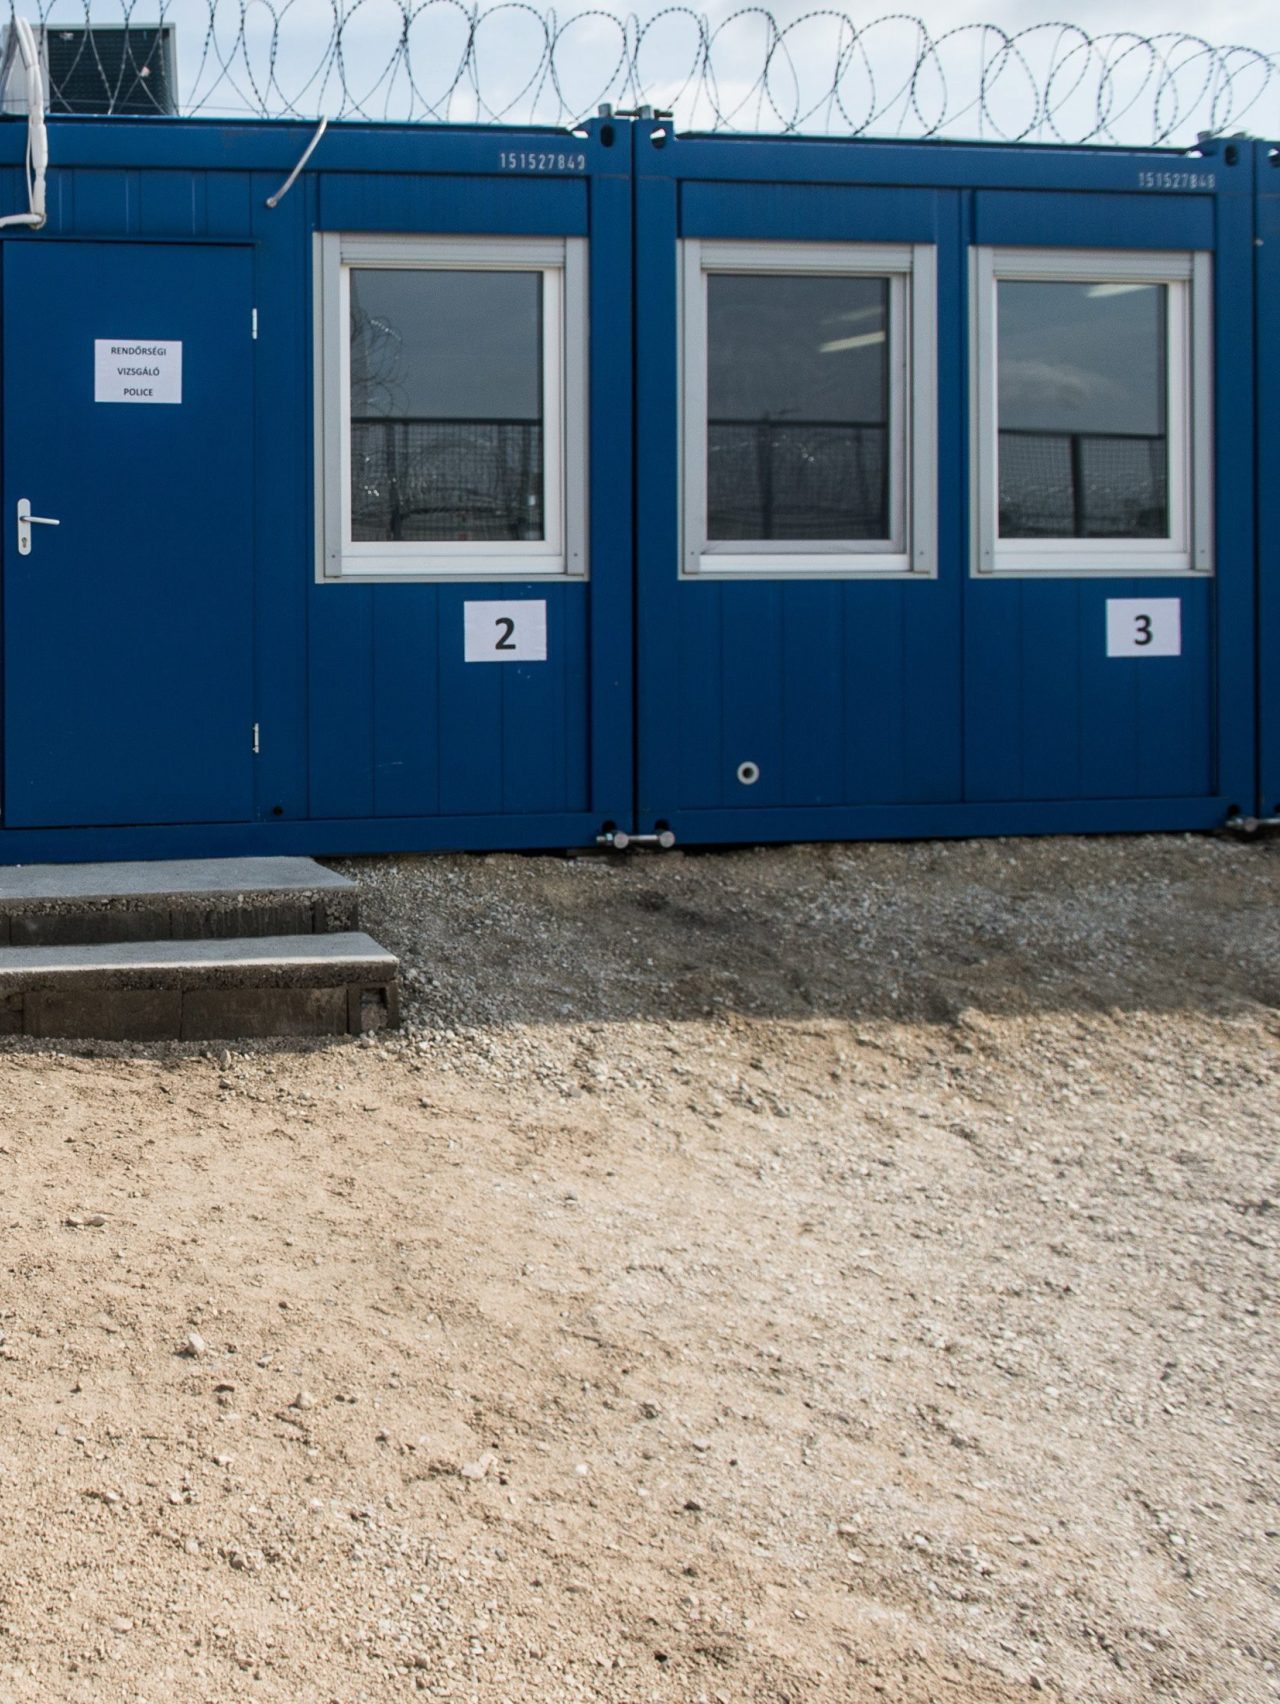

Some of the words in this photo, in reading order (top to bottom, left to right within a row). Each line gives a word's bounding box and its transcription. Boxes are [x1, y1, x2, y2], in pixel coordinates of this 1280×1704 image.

[500, 152, 586, 170] 151527849
[111, 345, 166, 356] RENDŐRSÉGI
[117, 366, 160, 376] VIZSGÁLÓ
[123, 388, 153, 396] POLICE
[495, 617, 516, 650] 2
[1134, 614, 1153, 646] 3
